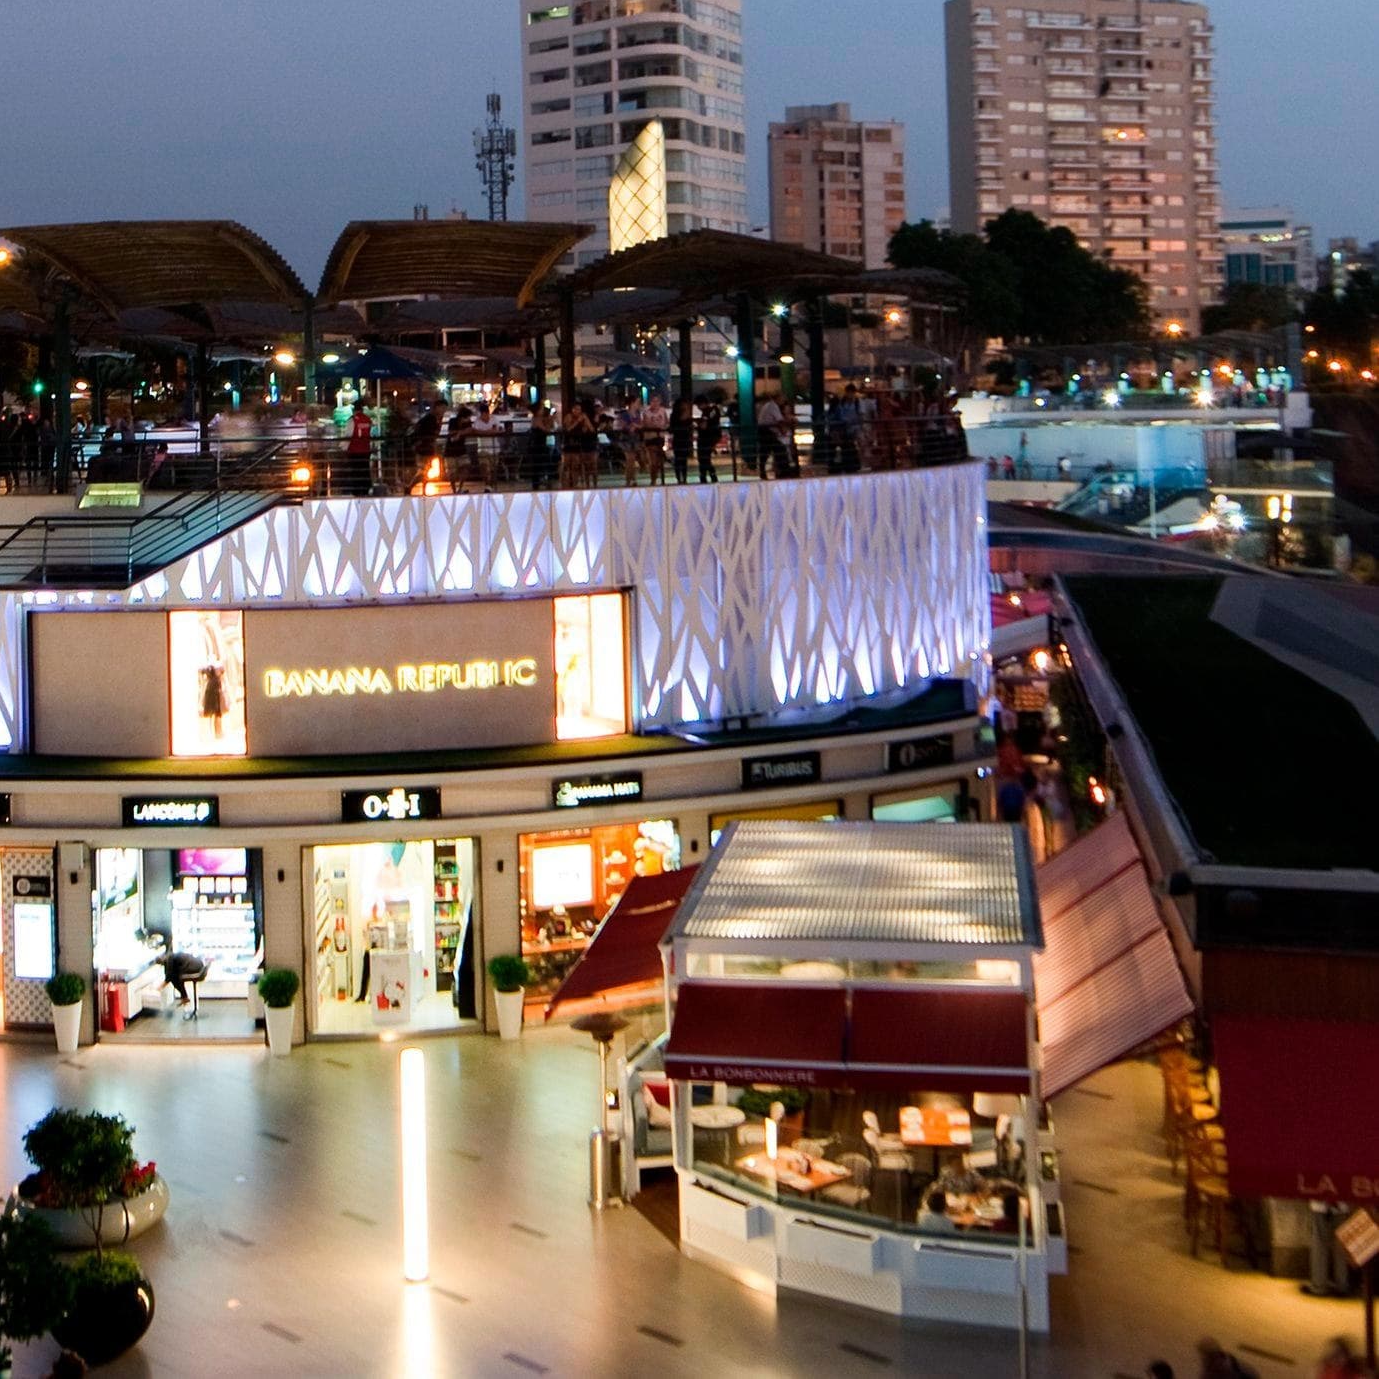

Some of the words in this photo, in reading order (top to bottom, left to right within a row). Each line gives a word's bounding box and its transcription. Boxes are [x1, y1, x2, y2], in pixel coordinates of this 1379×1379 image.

[265, 667, 393, 697] BANANA
[397, 659, 538, 693] REPUBLIC
[690, 1065, 709, 1078] LA
[1296, 1173, 1339, 1195] LA
